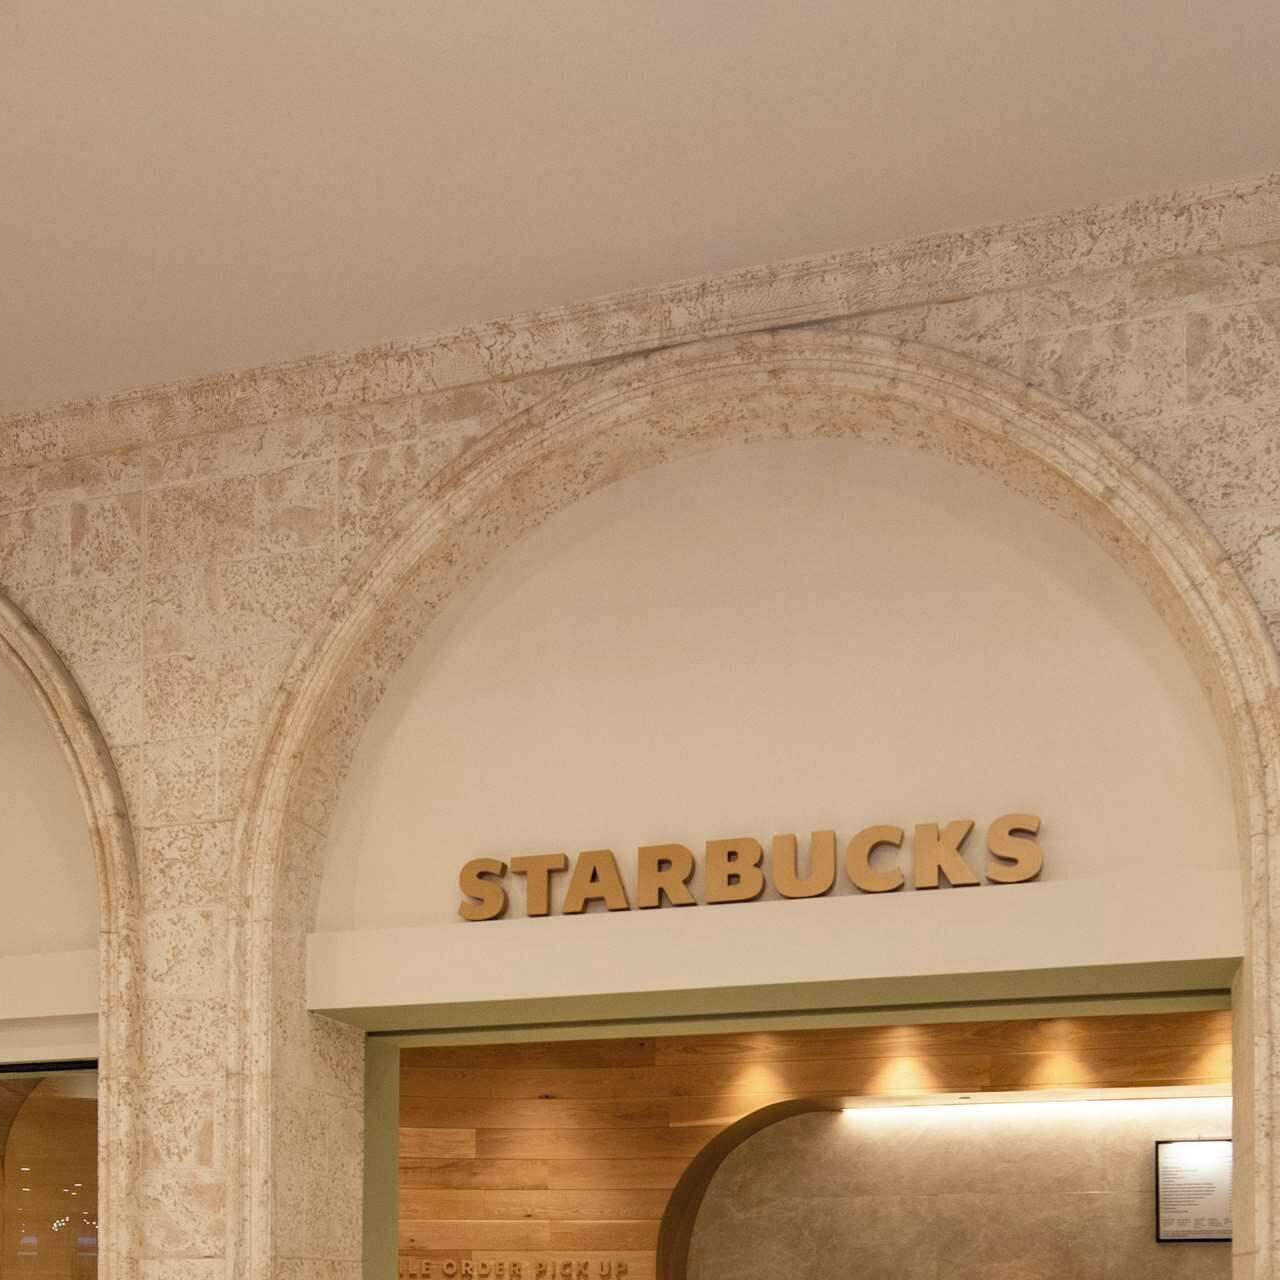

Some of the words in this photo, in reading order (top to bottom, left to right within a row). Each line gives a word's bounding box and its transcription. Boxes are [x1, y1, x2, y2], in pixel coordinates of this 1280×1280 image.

[456, 812, 1042, 922] STARBUCKS
[441, 1258, 522, 1280] ORDER
[534, 1259, 590, 1280] PICK
[598, 1259, 629, 1280] UP
